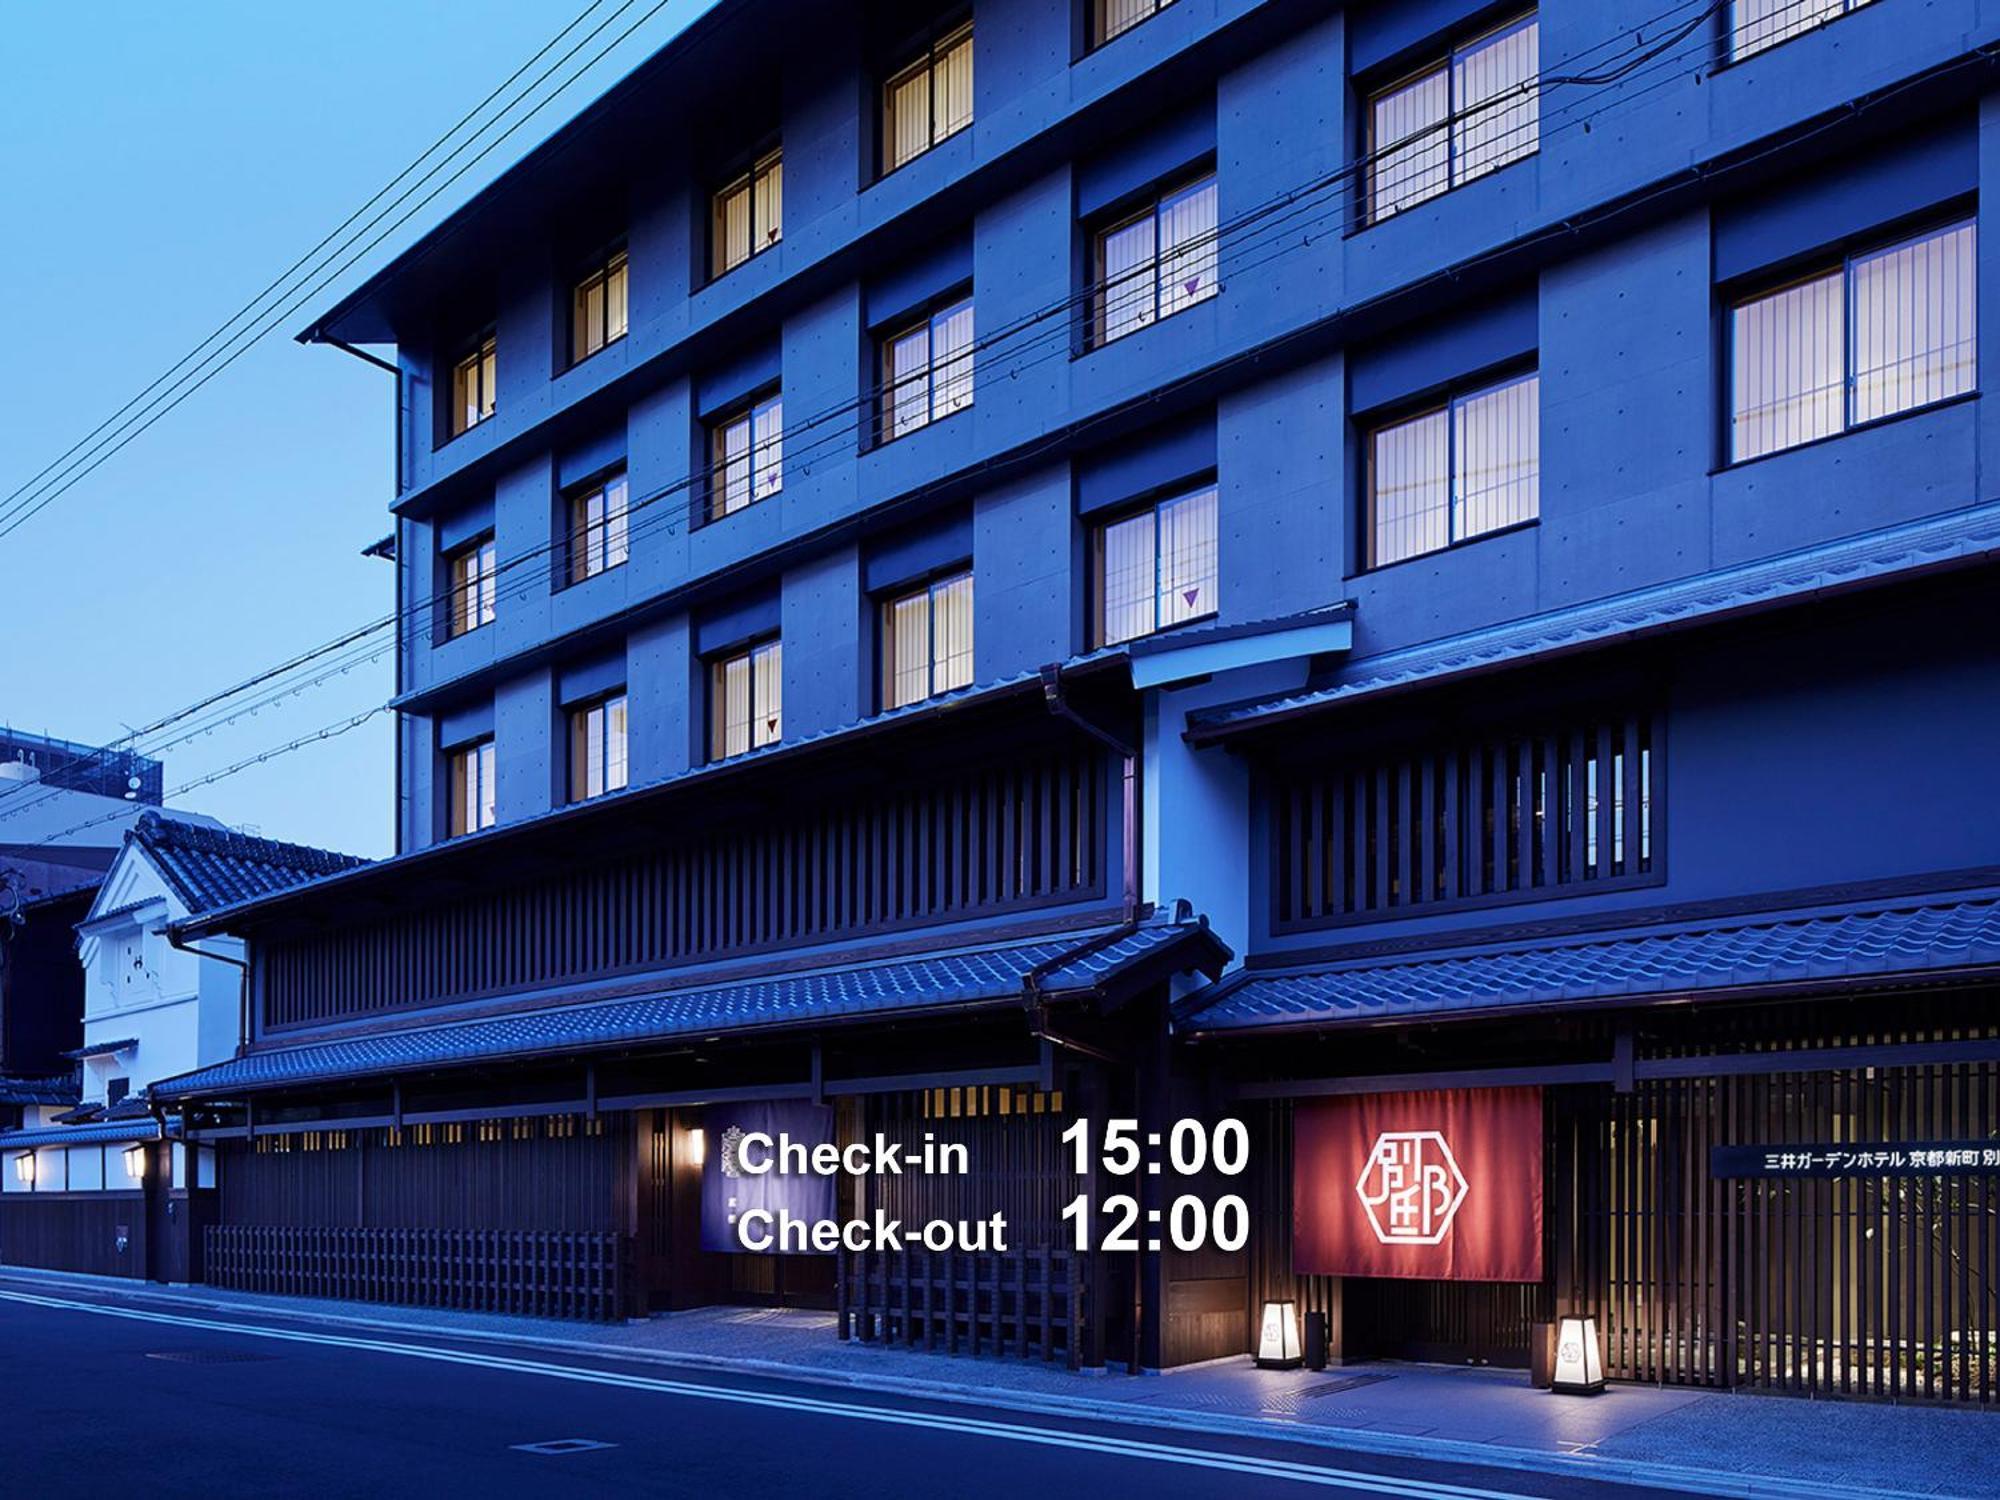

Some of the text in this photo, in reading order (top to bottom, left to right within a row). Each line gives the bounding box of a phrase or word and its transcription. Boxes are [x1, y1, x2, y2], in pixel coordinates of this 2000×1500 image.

[1764, 1150, 1906, 1170] 三井ガーデンホテル
[1909, 1149, 1980, 1168] 京都新町
